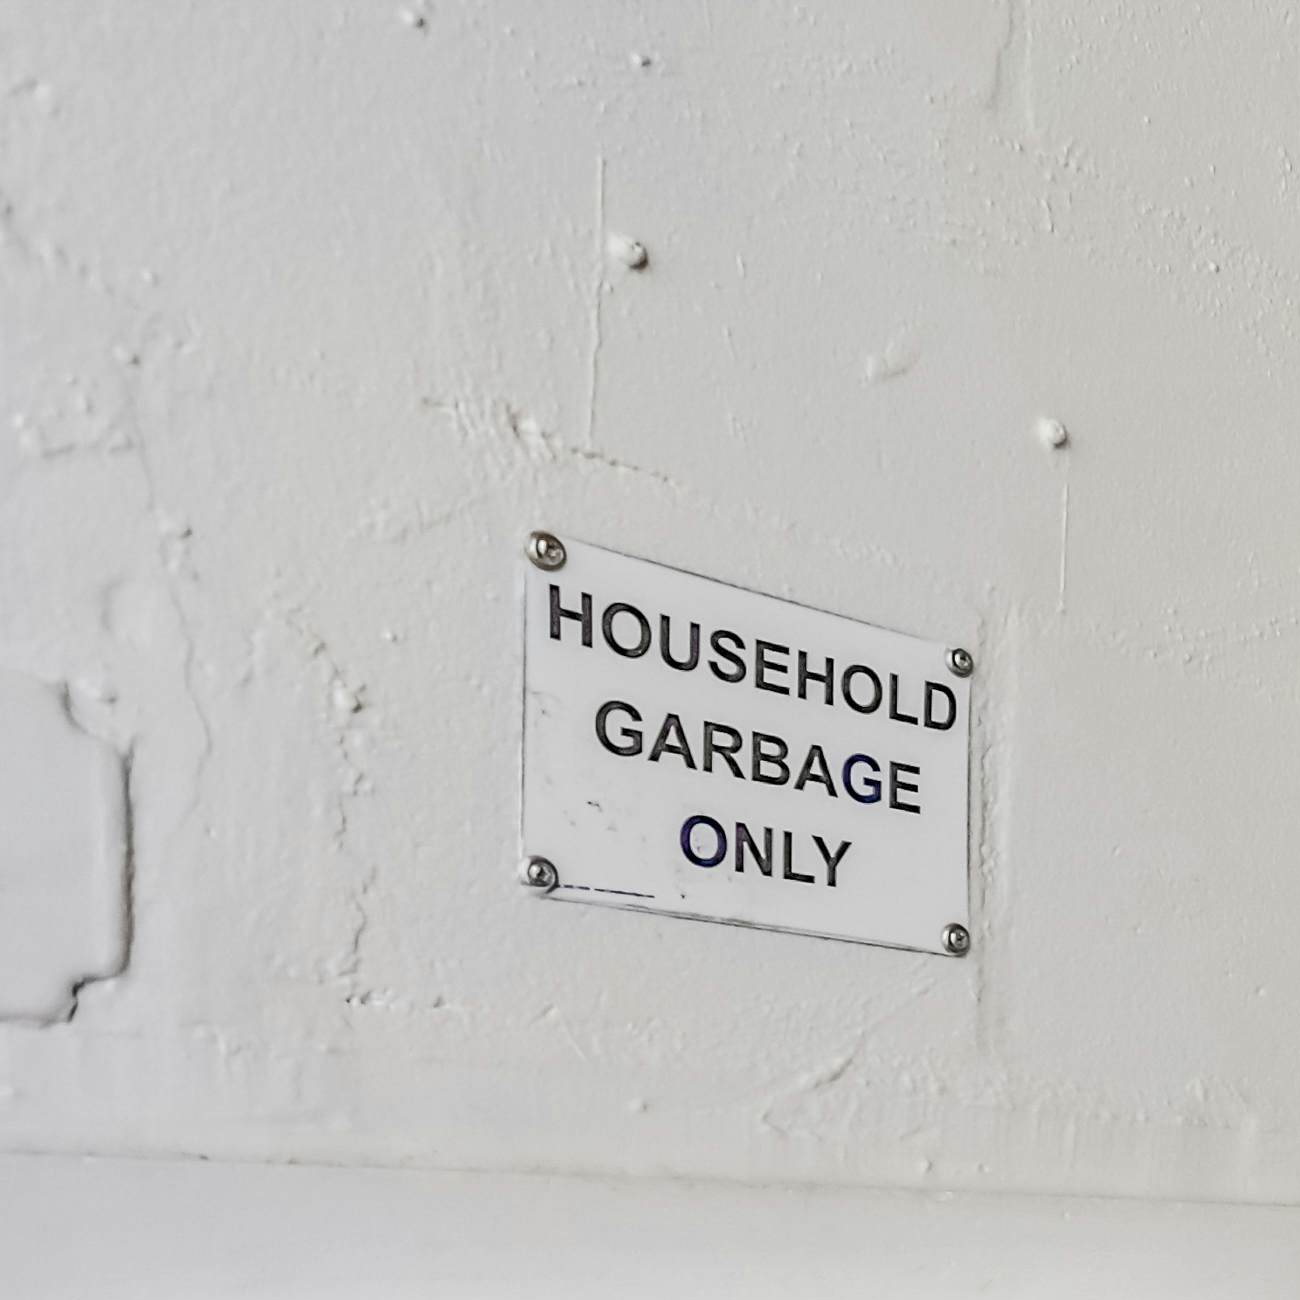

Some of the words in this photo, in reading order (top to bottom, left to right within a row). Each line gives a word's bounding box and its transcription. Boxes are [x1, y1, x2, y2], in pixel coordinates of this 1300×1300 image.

[549, 584, 957, 732] HOUSEHOLD
[595, 700, 921, 814] GARBAGE
[680, 815, 853, 887] ONLY
